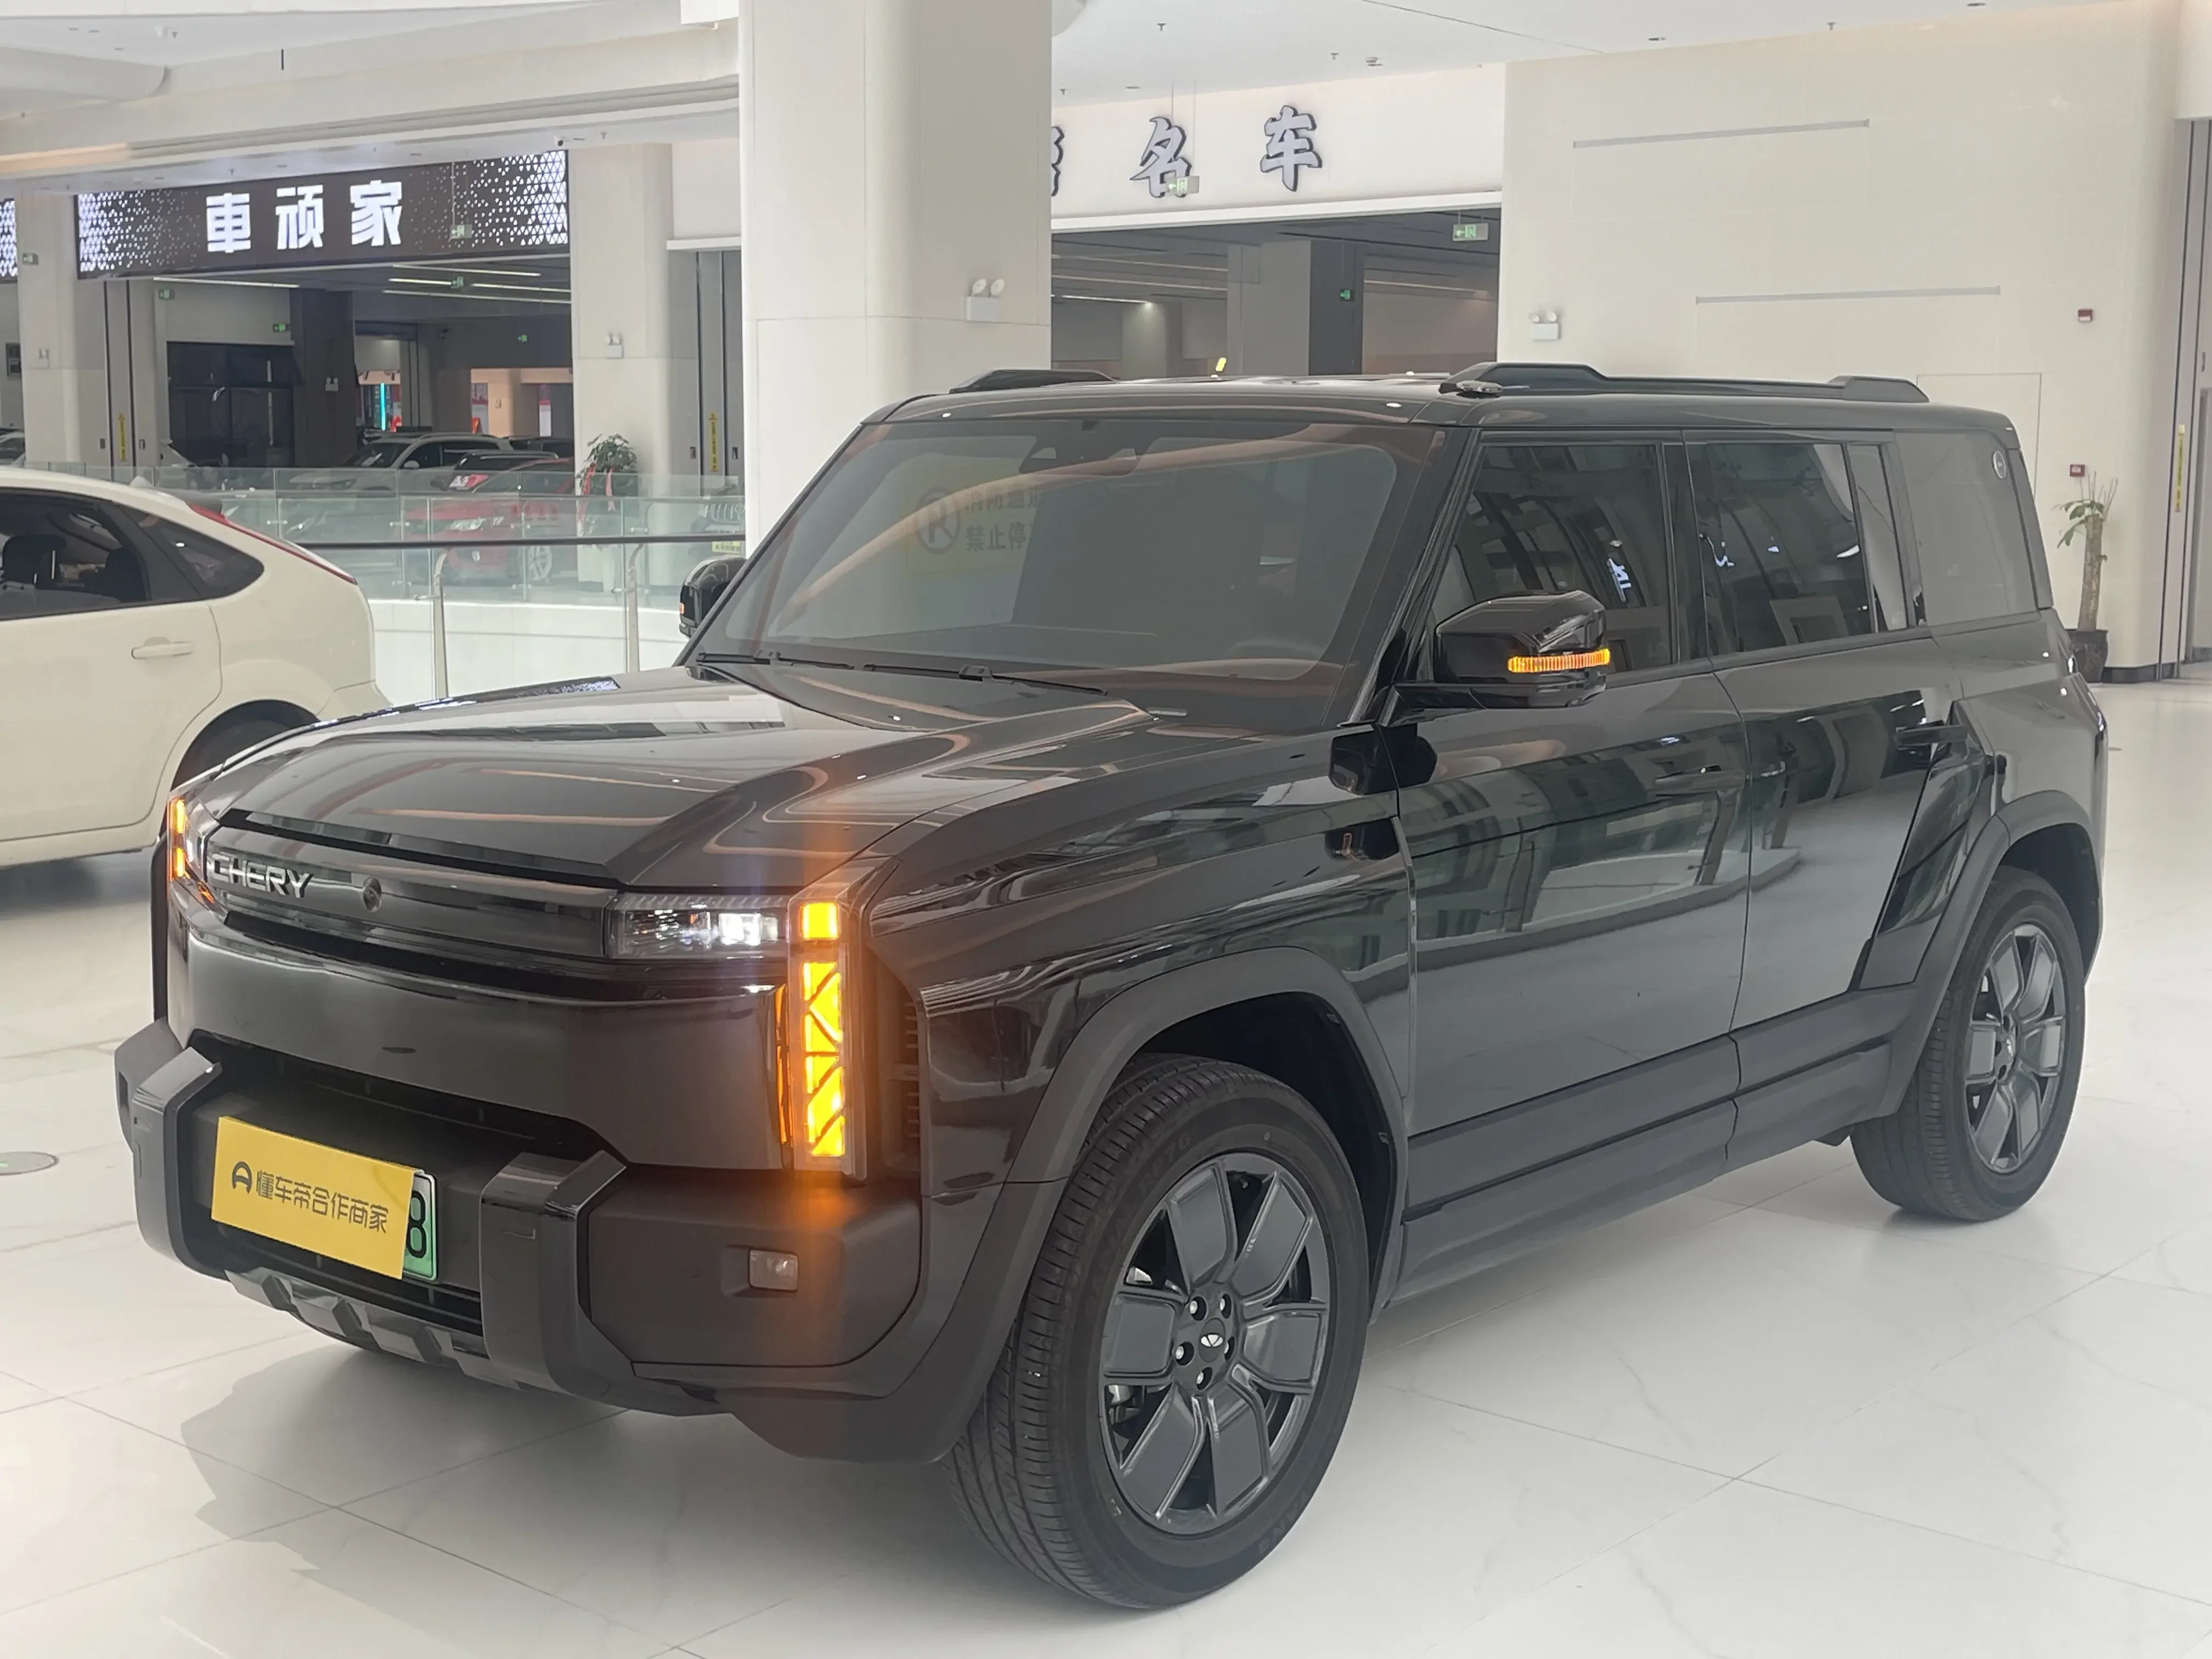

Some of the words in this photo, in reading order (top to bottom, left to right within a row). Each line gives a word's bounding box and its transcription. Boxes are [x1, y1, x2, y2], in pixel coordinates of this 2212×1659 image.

[1051, 105, 1323, 199] 名车
[206, 179, 403, 253] 車顽家
[965, 522, 1035, 552] 禁止停
[211, 853, 314, 899] CHERY
[256, 1170, 389, 1234] 懂车帝合作商家
[405, 1190, 427, 1259] 8
